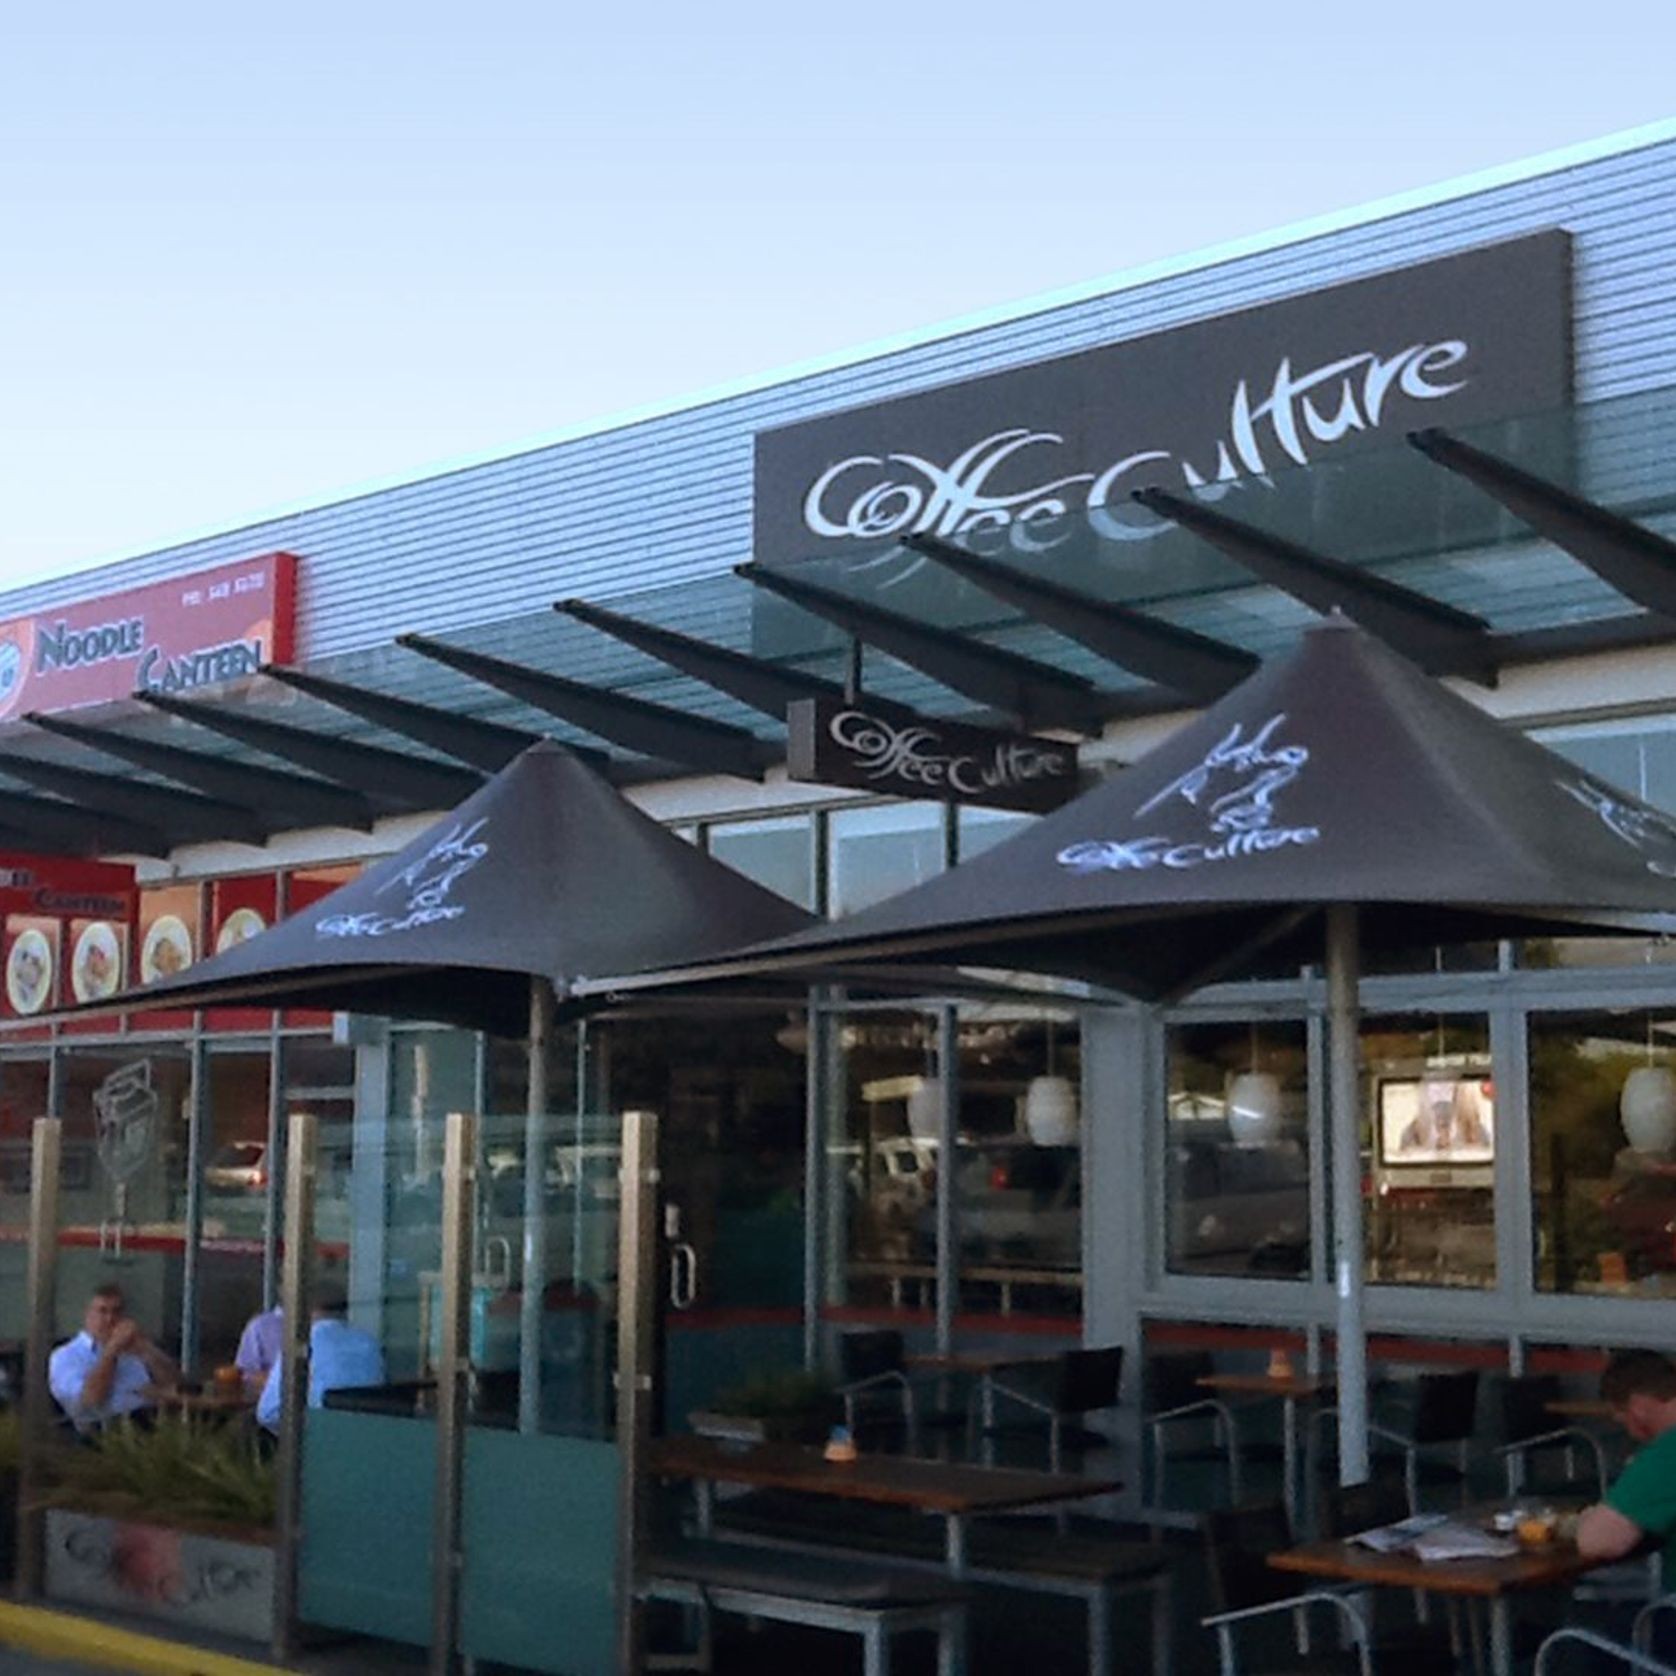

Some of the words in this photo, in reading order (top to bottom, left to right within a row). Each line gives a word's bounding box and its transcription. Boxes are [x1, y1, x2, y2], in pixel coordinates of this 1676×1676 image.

[804, 428, 1096, 589] Coffee
[1086, 337, 1469, 542] Culture
[829, 711, 951, 781] Coffee
[948, 744, 1064, 795] Culture
